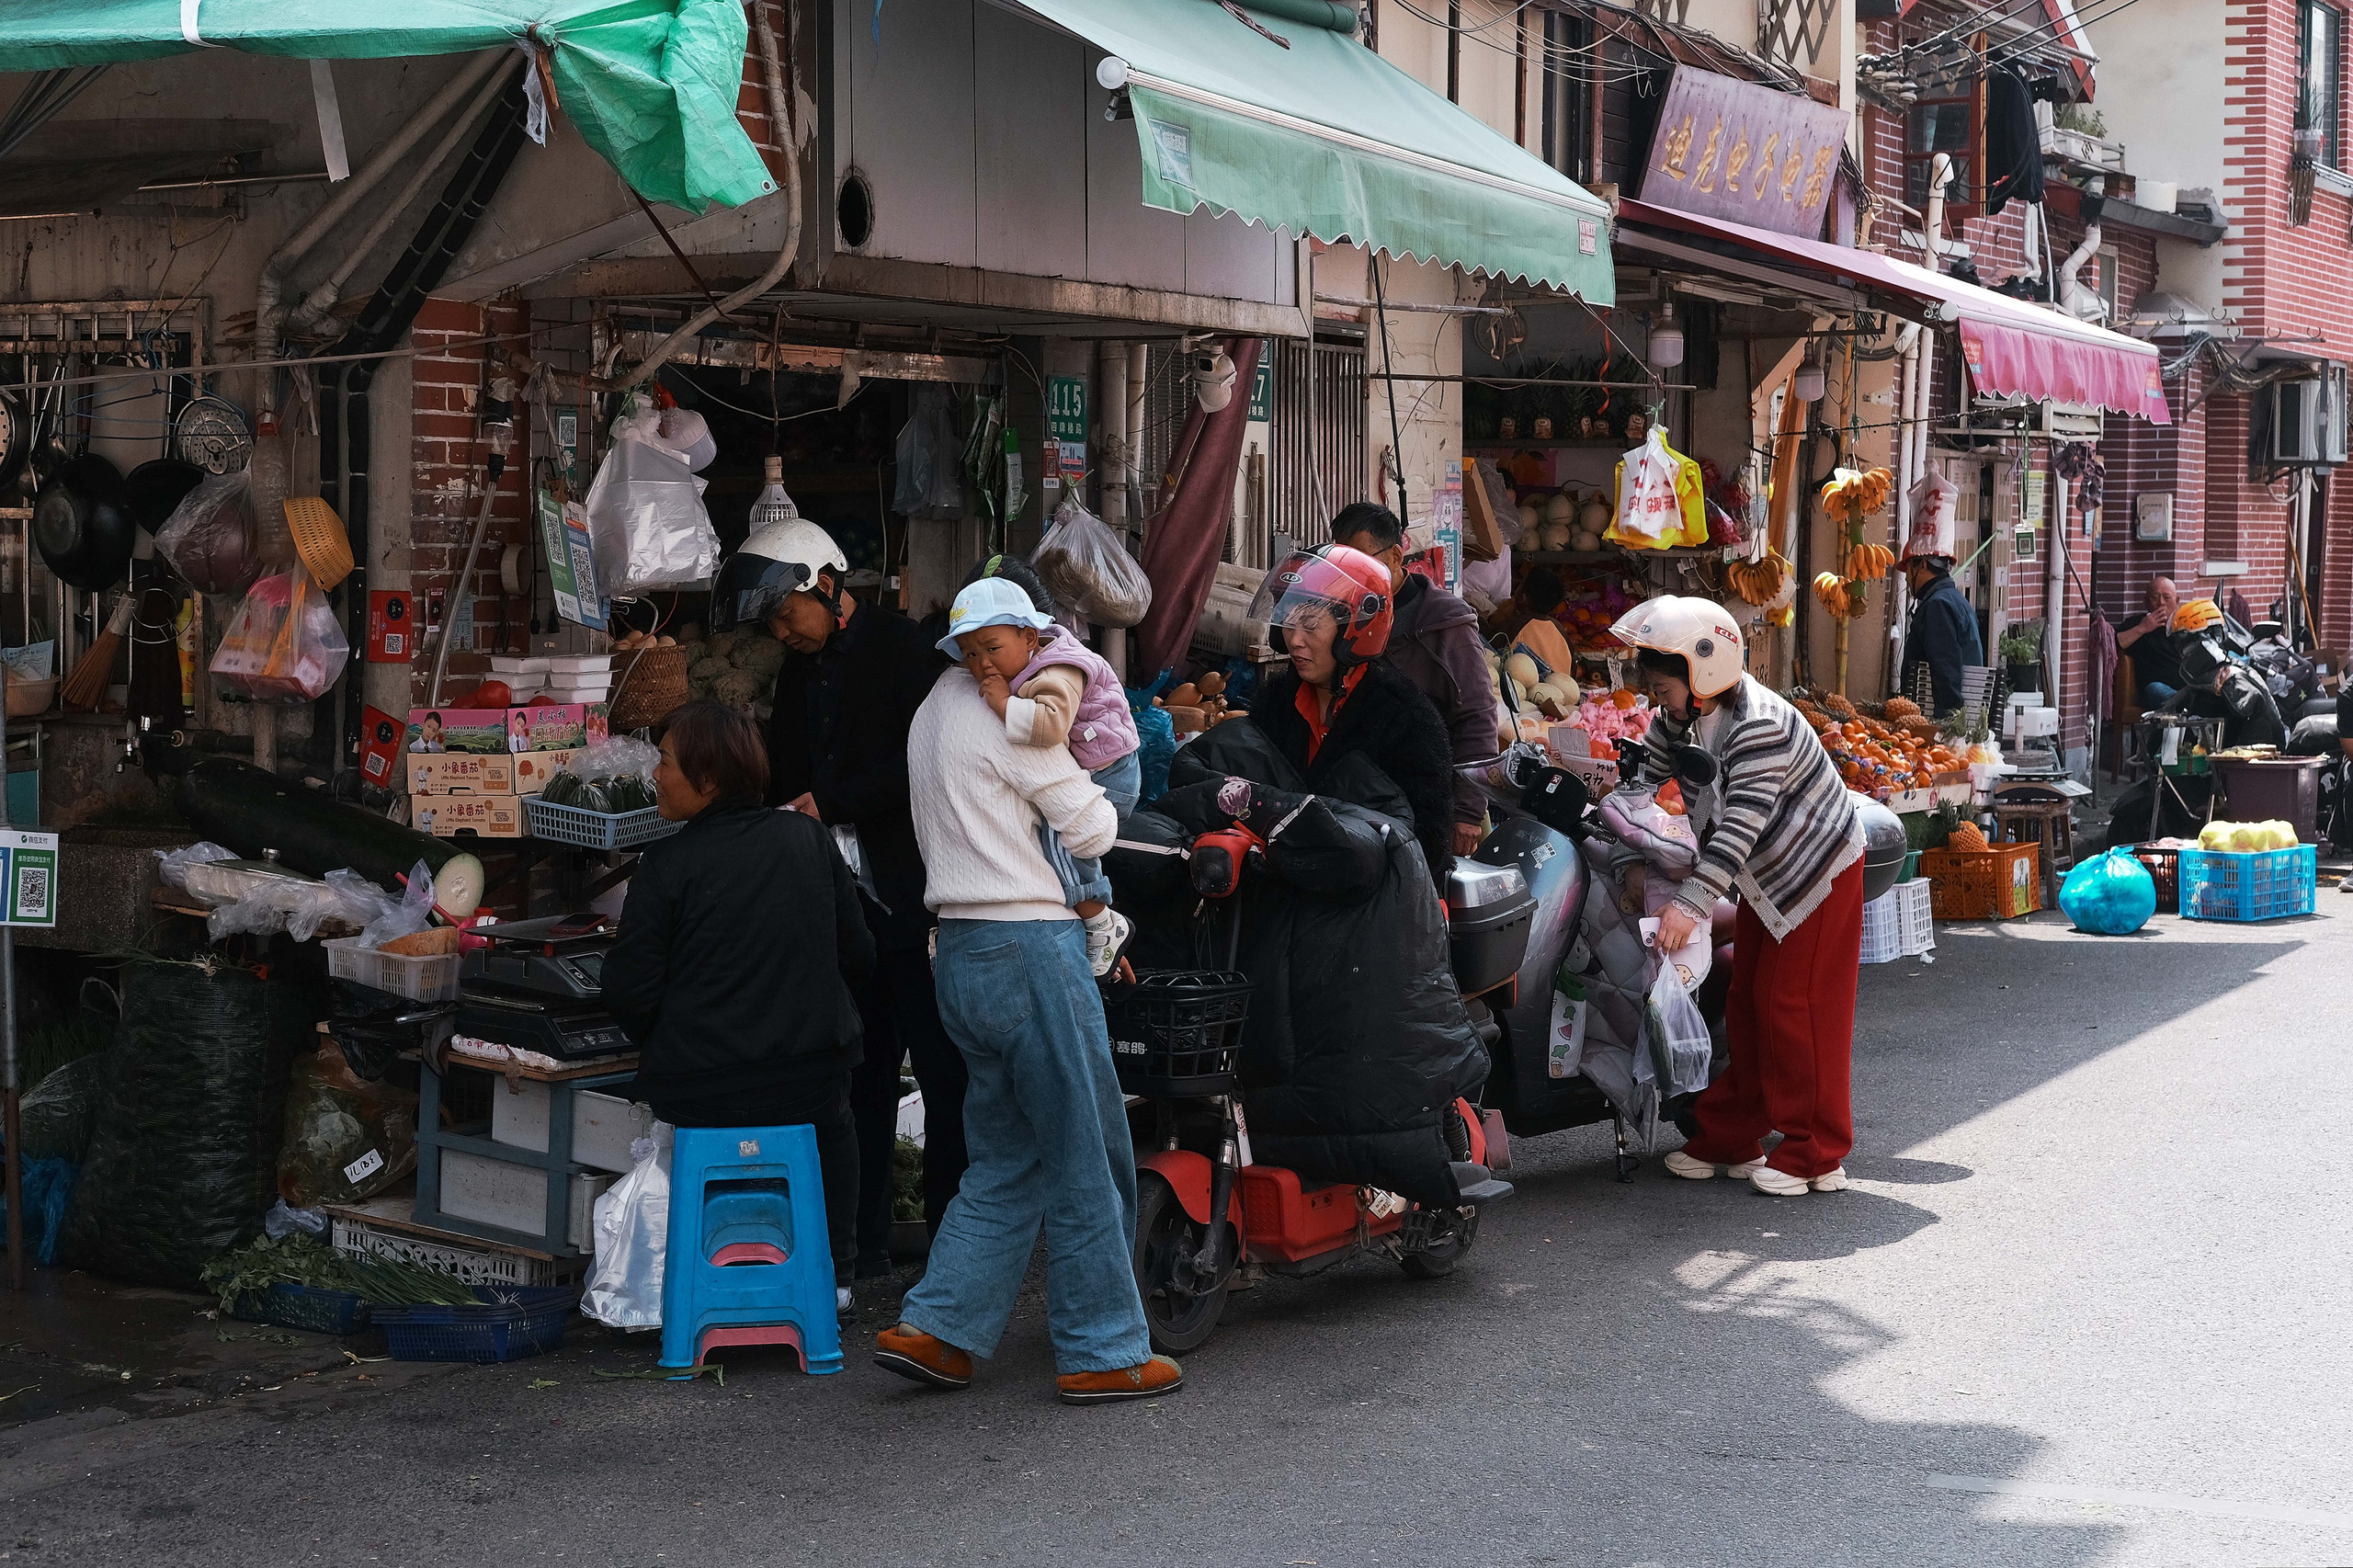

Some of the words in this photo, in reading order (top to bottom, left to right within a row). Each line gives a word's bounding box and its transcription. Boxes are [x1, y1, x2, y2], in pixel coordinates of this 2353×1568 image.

[1251, 374, 1266, 402] 7
[1051, 383, 1082, 417] 115
[1051, 421, 1082, 435] 四牌楼路
[1719, 629, 1735, 641] CLF
[441, 761, 479, 774] 小象番茄
[447, 803, 484, 816] 小象番茄
